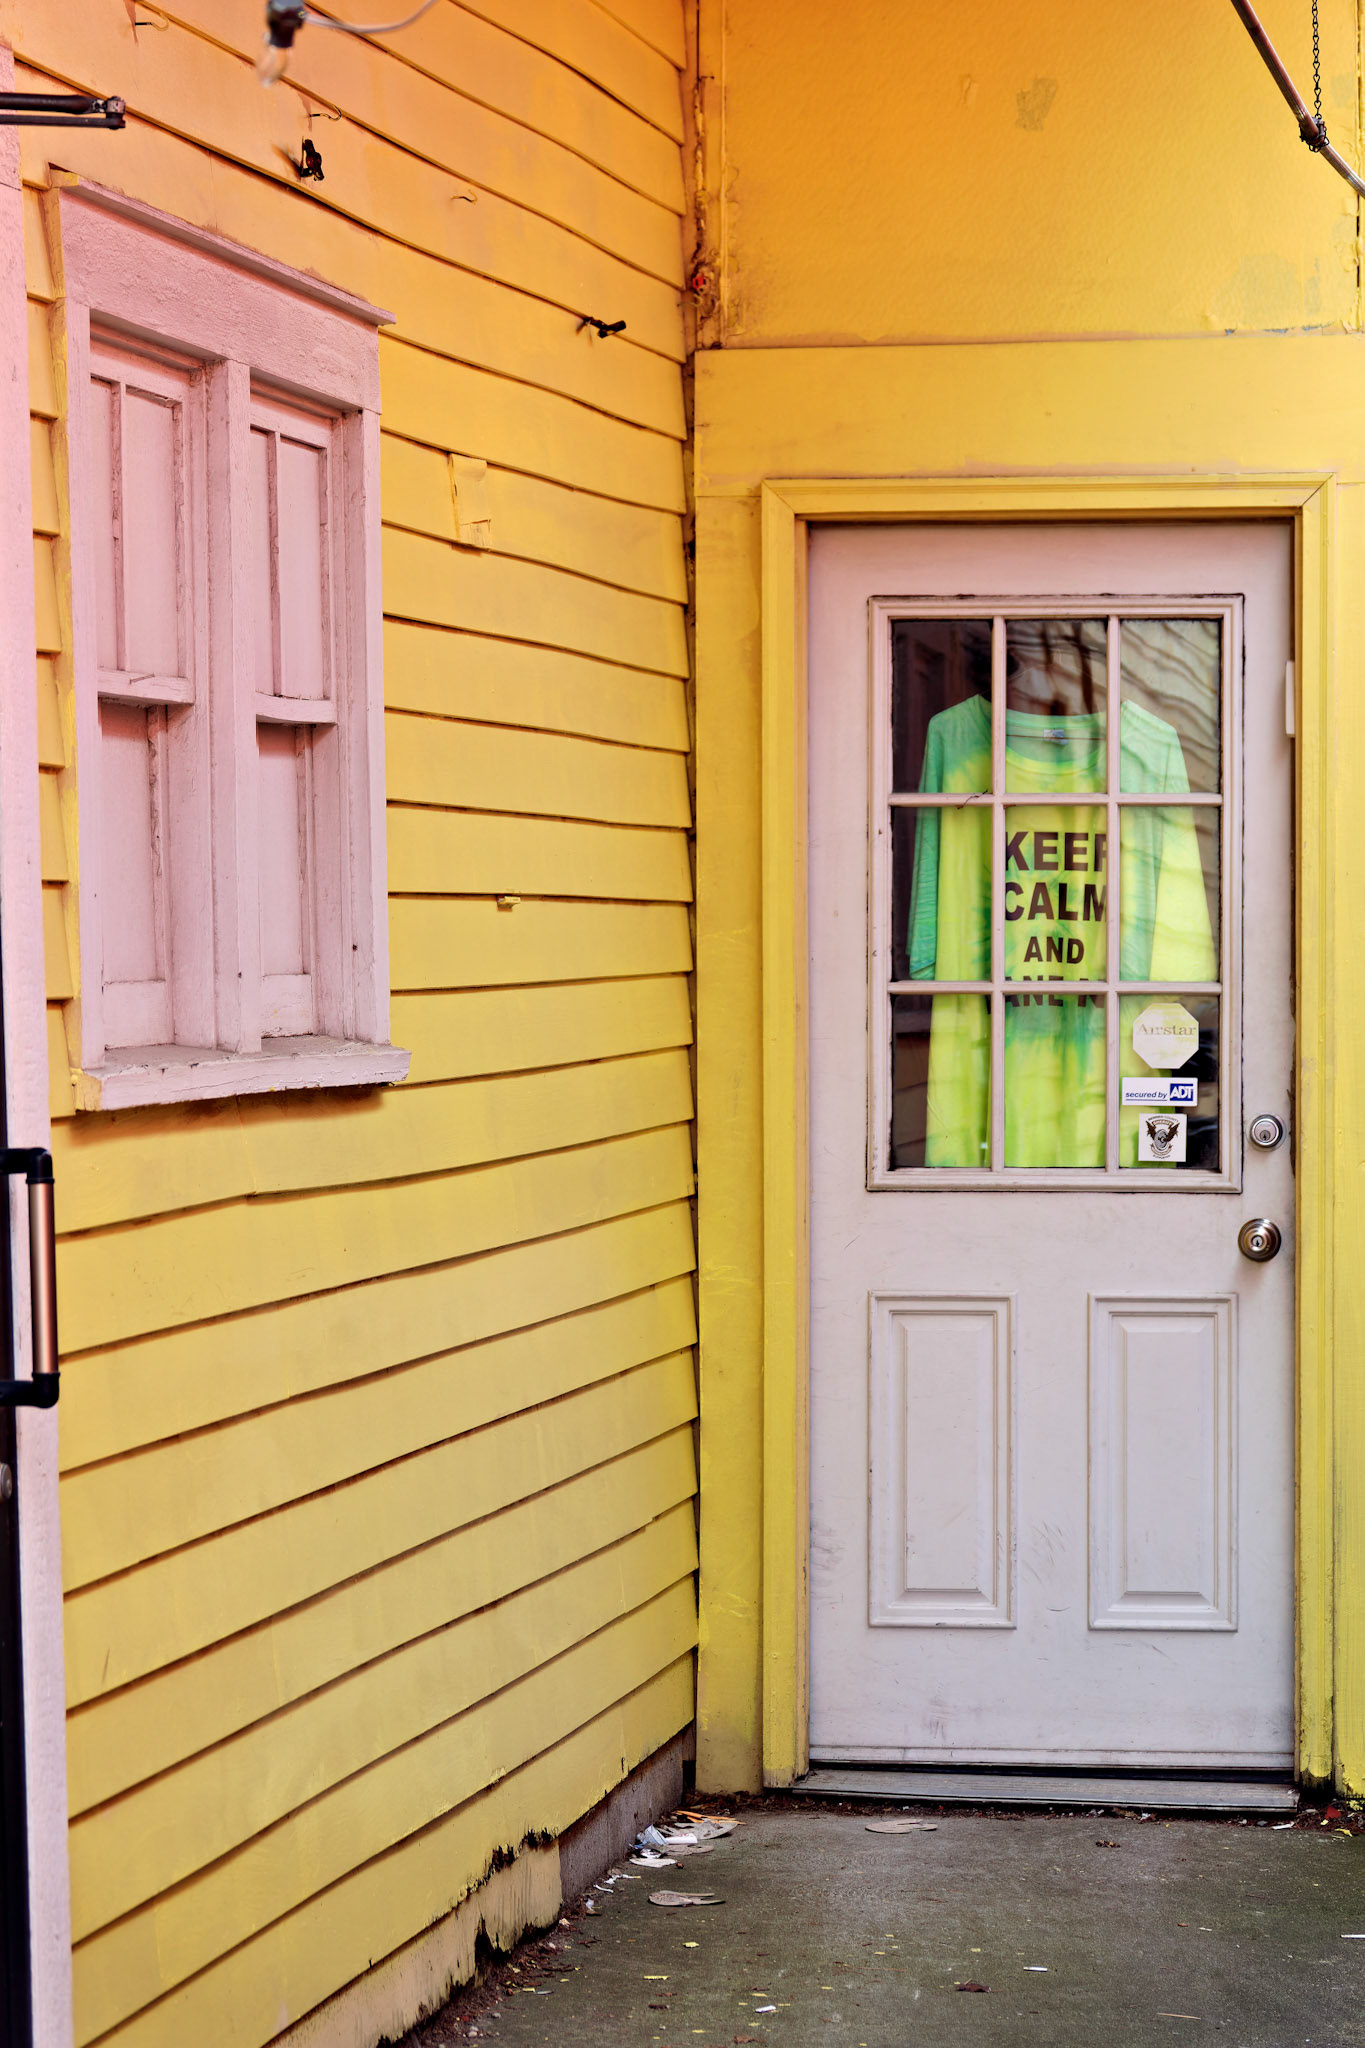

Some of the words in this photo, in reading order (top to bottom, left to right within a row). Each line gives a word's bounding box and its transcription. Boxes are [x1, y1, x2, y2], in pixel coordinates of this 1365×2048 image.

[1005, 881, 1107, 922] CALM
[1023, 936, 1085, 964] AND
[1158, 1091, 1168, 1099] by
[1170, 1085, 1194, 1100] ADT
